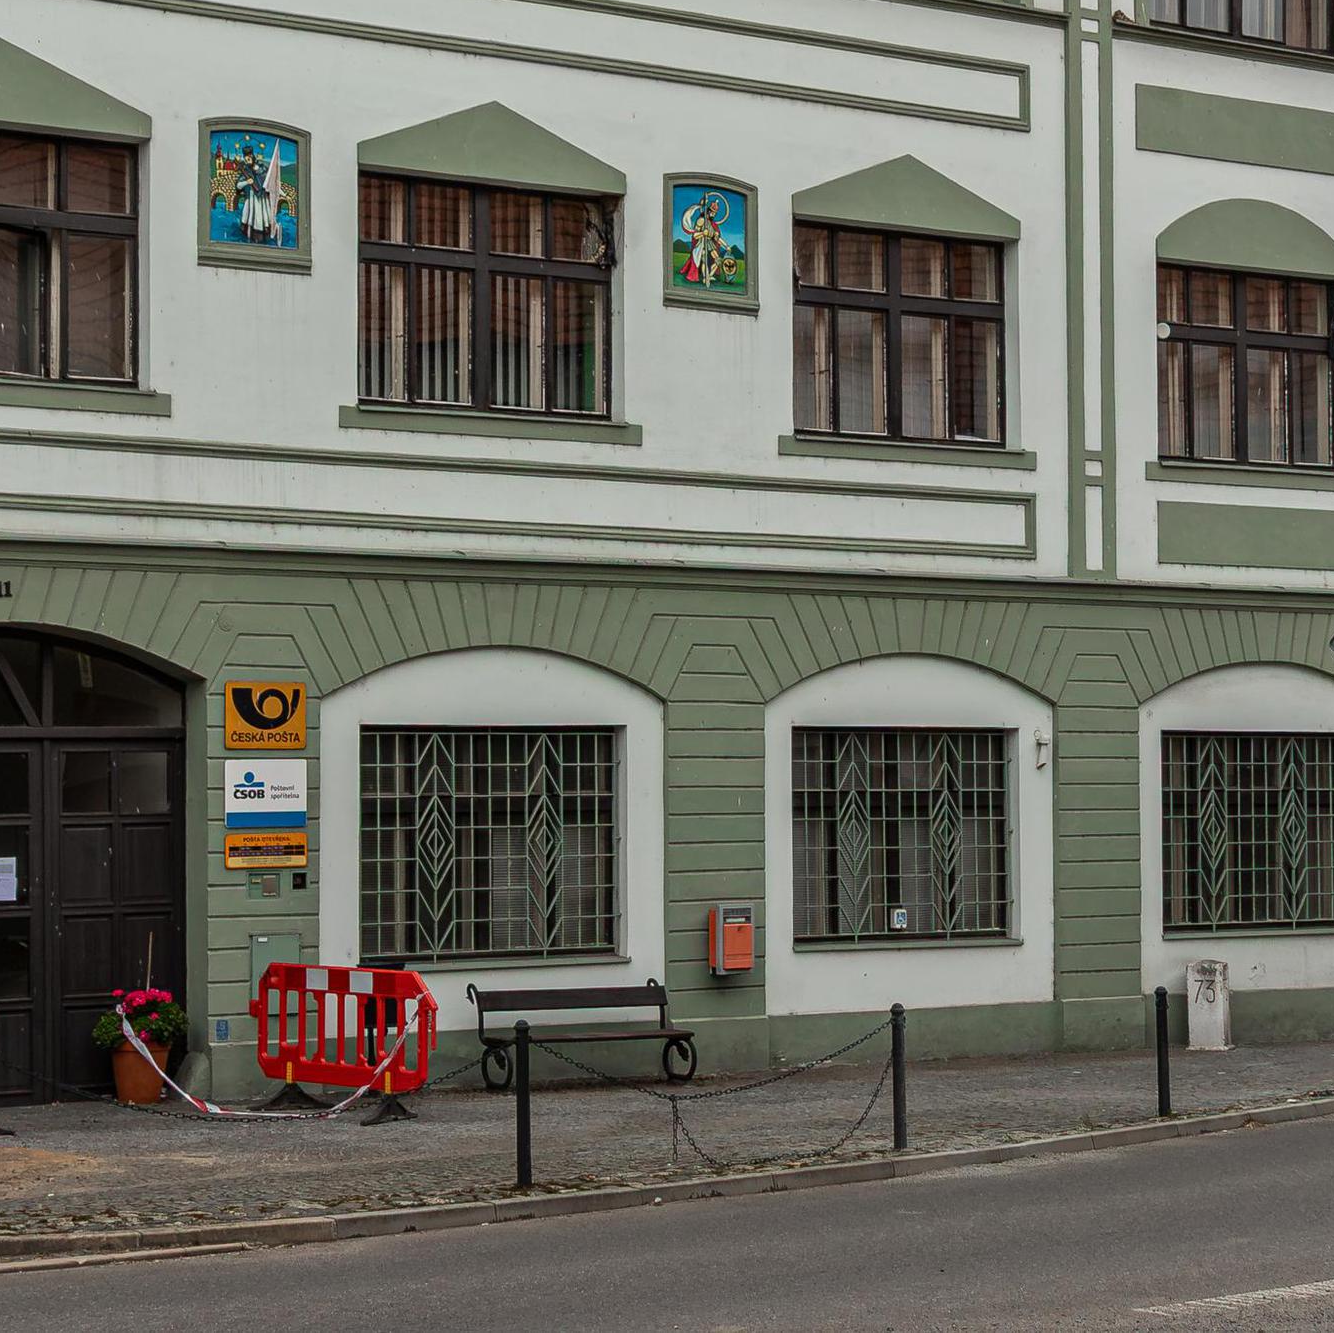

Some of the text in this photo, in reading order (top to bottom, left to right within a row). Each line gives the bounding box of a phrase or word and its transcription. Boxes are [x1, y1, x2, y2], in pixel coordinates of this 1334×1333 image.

[231, 731, 300, 742] ČESKÁ POŠTA
[233, 789, 265, 799] ČSOB
[270, 792, 300, 800] spořitelna
[1194, 979, 1216, 1004] 73
